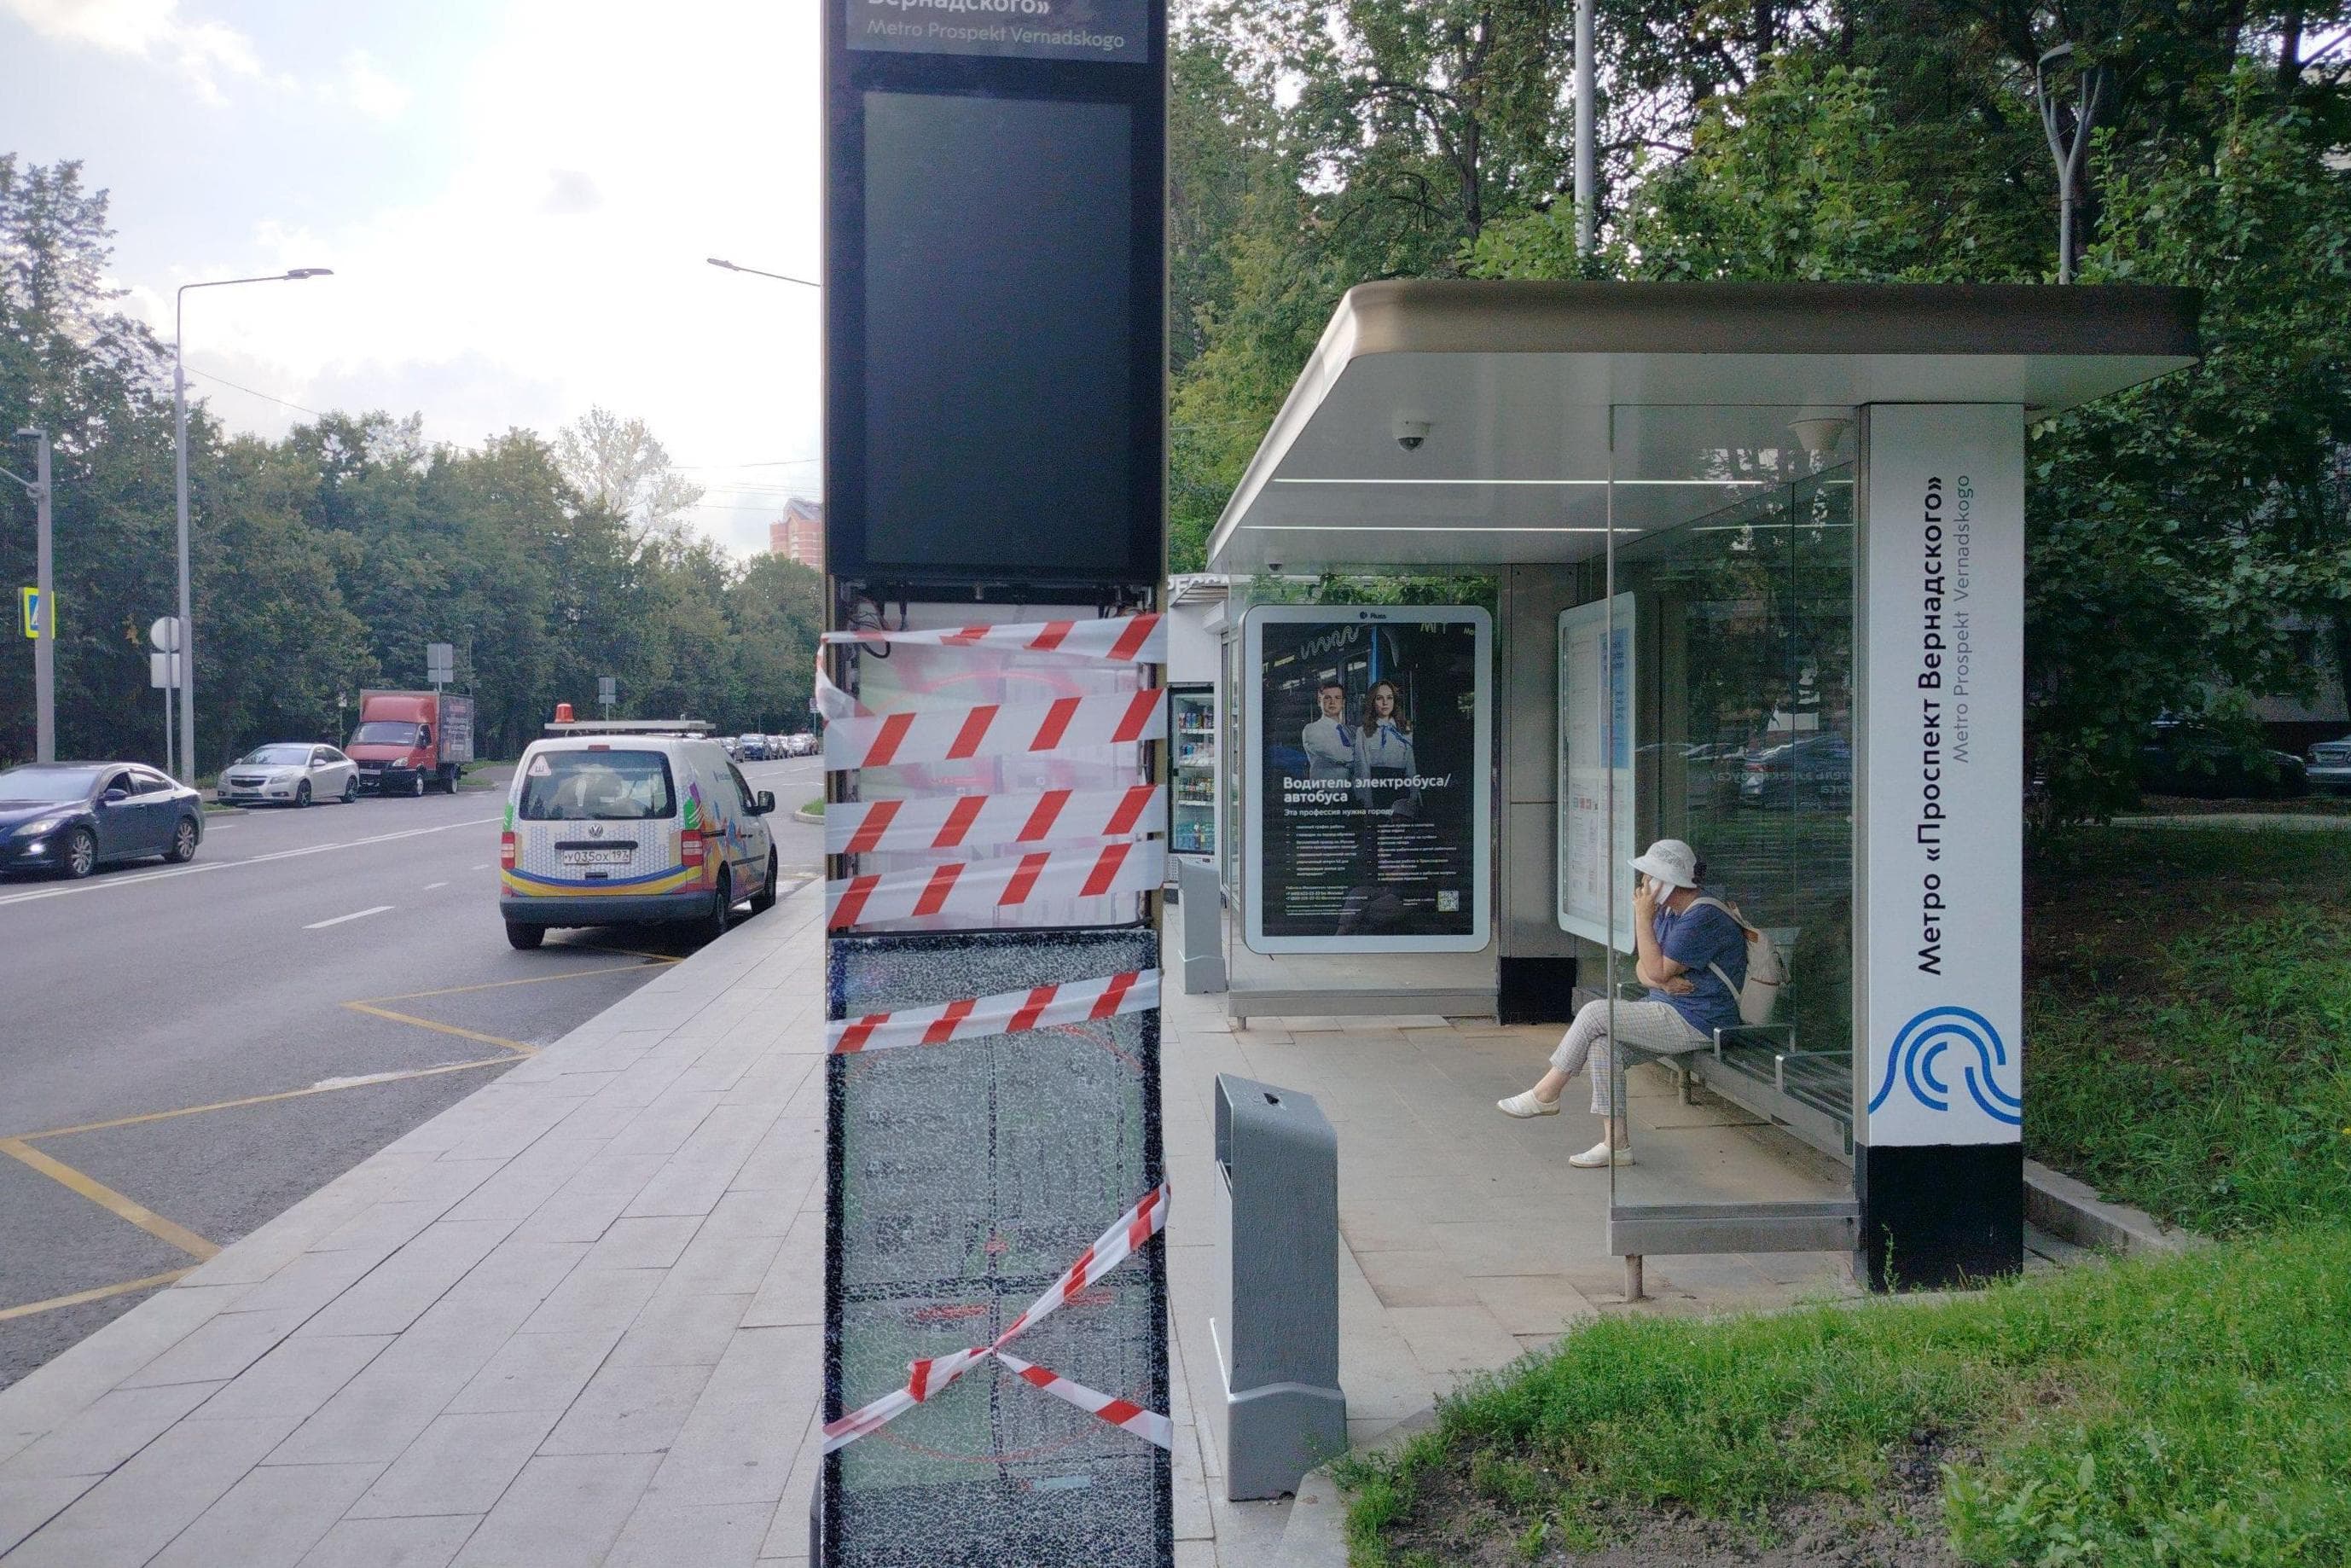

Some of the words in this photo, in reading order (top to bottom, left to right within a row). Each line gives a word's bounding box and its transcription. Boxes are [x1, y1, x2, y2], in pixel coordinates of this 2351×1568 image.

[867, 20, 922, 37] Metro
[928, 22, 1006, 43] Prospekt
[1011, 26, 1124, 51] Vernadskogo
[1953, 475, 1973, 601] Vernadskogo
[1918, 476, 1946, 689] Вернадского»
[1953, 611, 1972, 695] Prospekt
[1953, 704, 1969, 764] Metro
[1283, 776, 1351, 790] Водитель
[1355, 774, 1451, 791] электробуса/
[1284, 790, 1348, 805] автобуса
[1299, 809, 1341, 817] профессия
[1918, 699, 1946, 862] «Проспект
[1918, 874, 1946, 976] Метро
